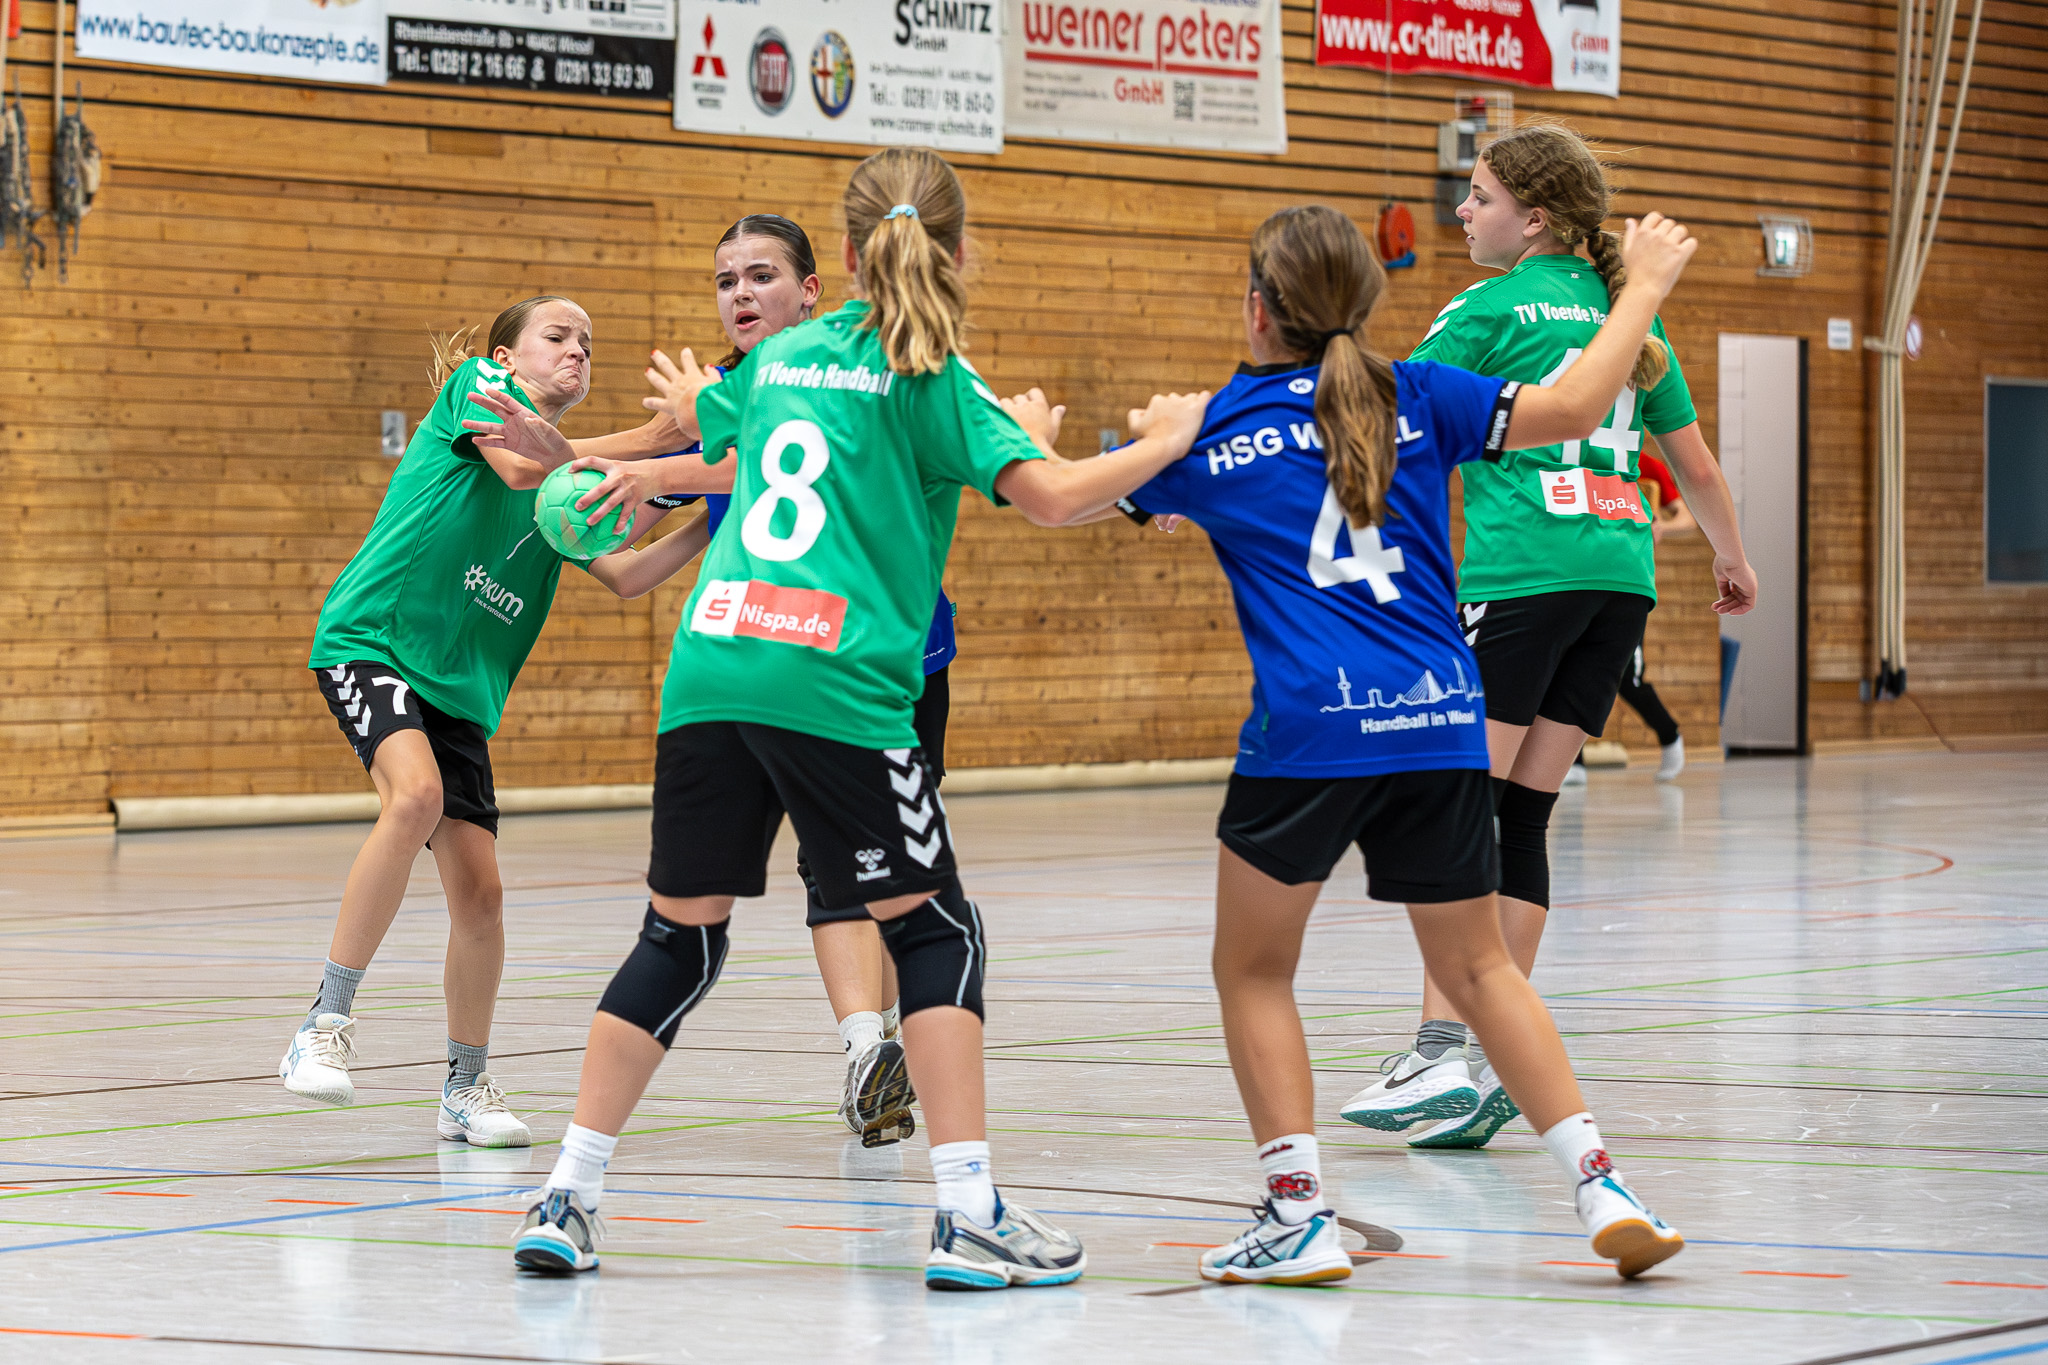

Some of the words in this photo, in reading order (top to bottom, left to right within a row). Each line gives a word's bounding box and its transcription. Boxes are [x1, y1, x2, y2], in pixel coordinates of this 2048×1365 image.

[81, 13, 380, 64] www.bautec-baukonzepte.de
[894, 0, 991, 46] SCHMITZ
[1024, 2, 1144, 51] werner
[1156, 7, 1261, 72] peters
[1321, 13, 1524, 70] www.cr-direkt.de
[394, 45, 429, 73] Tel.:
[430, 48, 468, 76] 0281
[469, 51, 482, 77] 2
[530, 56, 546, 81] &
[1114, 77, 1165, 105] GmbH
[1513, 303, 1538, 325] TV
[1537, 302, 1591, 323] Voerde
[768, 360, 824, 389] Voerde
[822, 363, 895, 396] Handball
[1206, 427, 1285, 476] HSG
[741, 419, 831, 562] 8
[1307, 482, 1406, 604] 4
[739, 603, 831, 638] Nispa.de
[372, 676, 409, 715] 7
[1360, 714, 1430, 734] Handball
